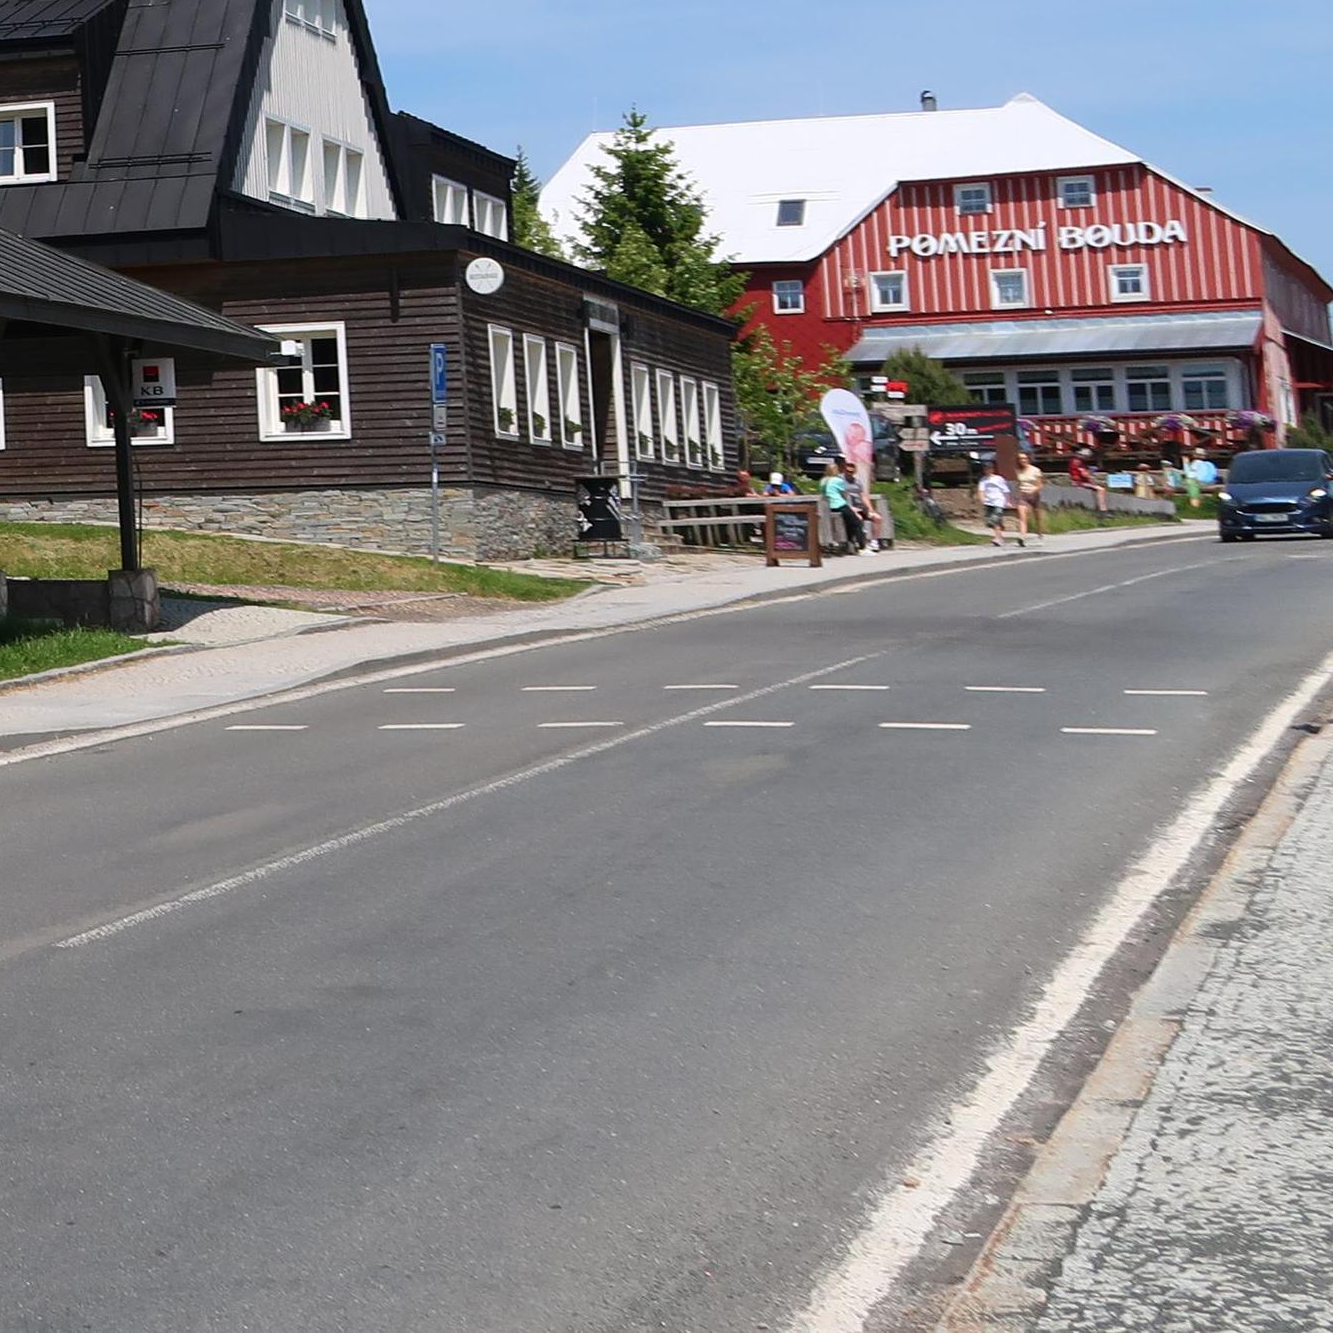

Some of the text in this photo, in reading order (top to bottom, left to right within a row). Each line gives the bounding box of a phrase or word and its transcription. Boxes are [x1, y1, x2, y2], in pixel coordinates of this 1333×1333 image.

[887, 220, 1188, 258] POMEZNÍ BOUDA
[140, 385, 164, 396] KB
